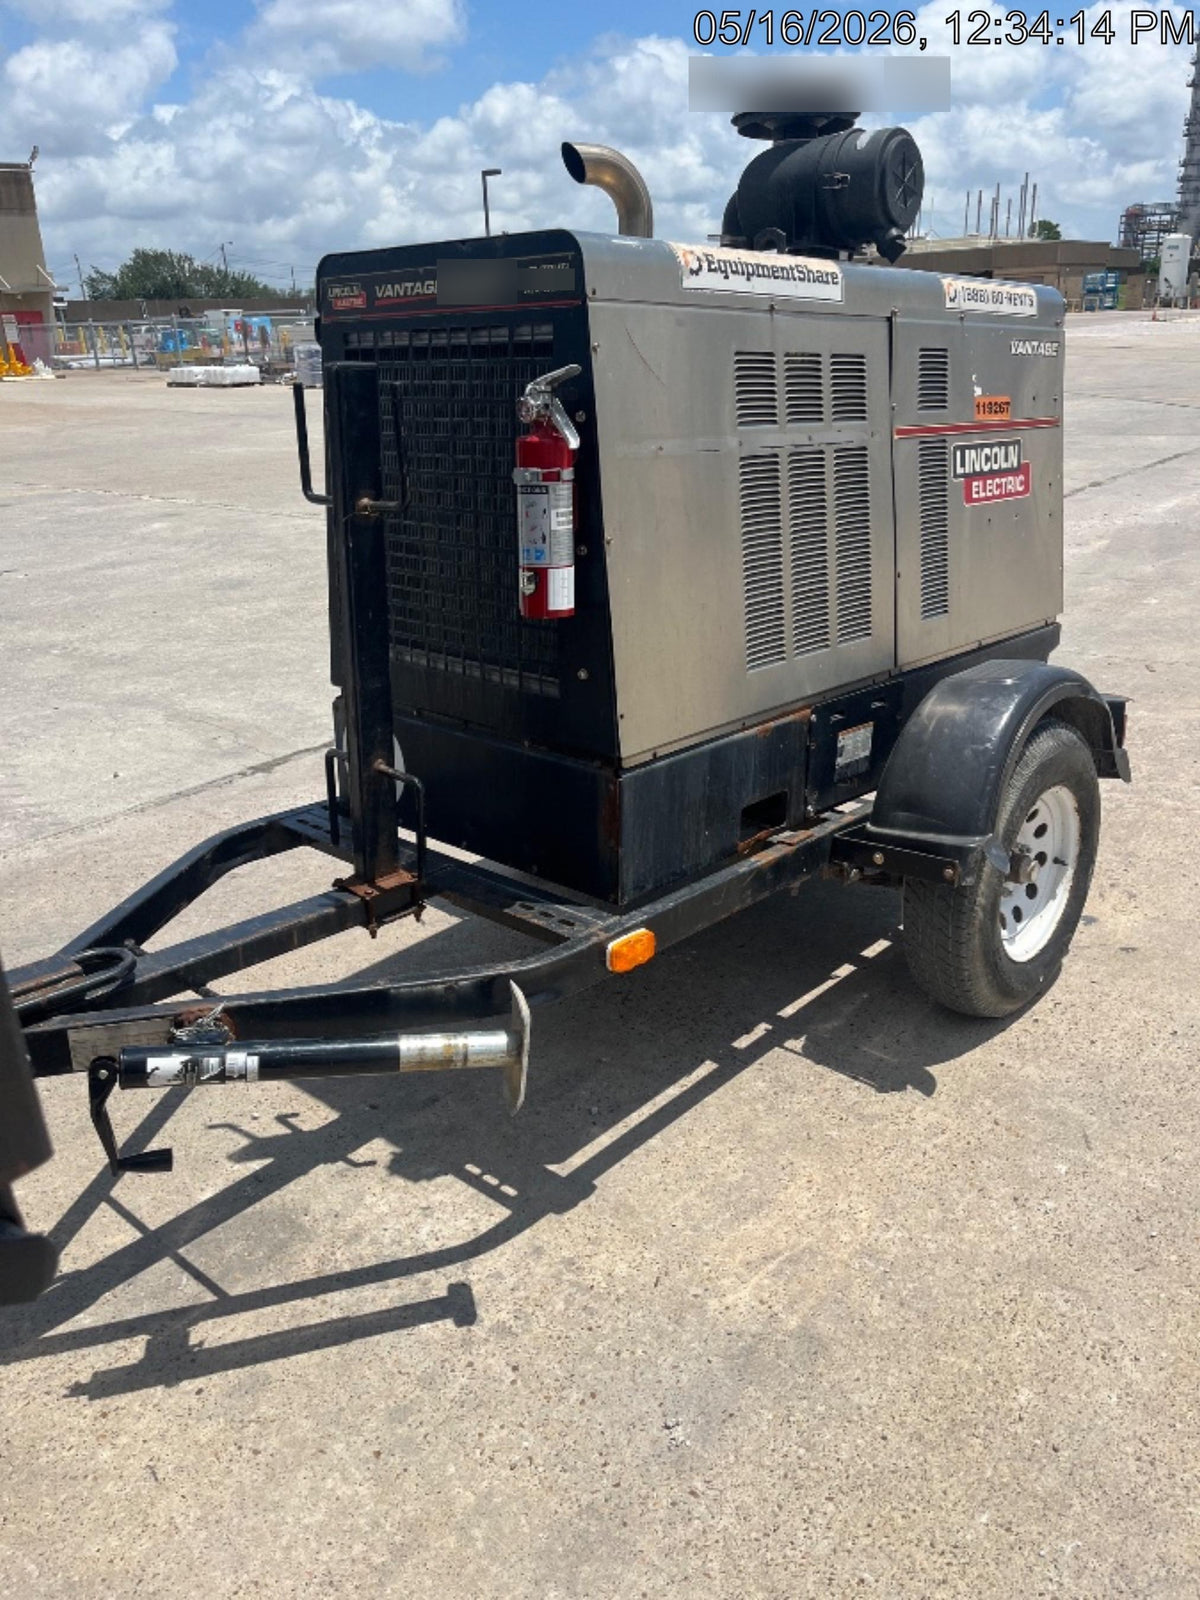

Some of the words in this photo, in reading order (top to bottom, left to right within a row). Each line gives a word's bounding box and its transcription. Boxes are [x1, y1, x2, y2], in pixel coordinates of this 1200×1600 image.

[703, 252, 840, 286] EquipmentShare
[375, 279, 438, 298] VANTAG
[1010, 340, 1060, 357] VANTAGE
[975, 401, 1011, 415] 119267
[956, 444, 1019, 475] LINCOLN
[971, 474, 1026, 499] ELECTRIC
